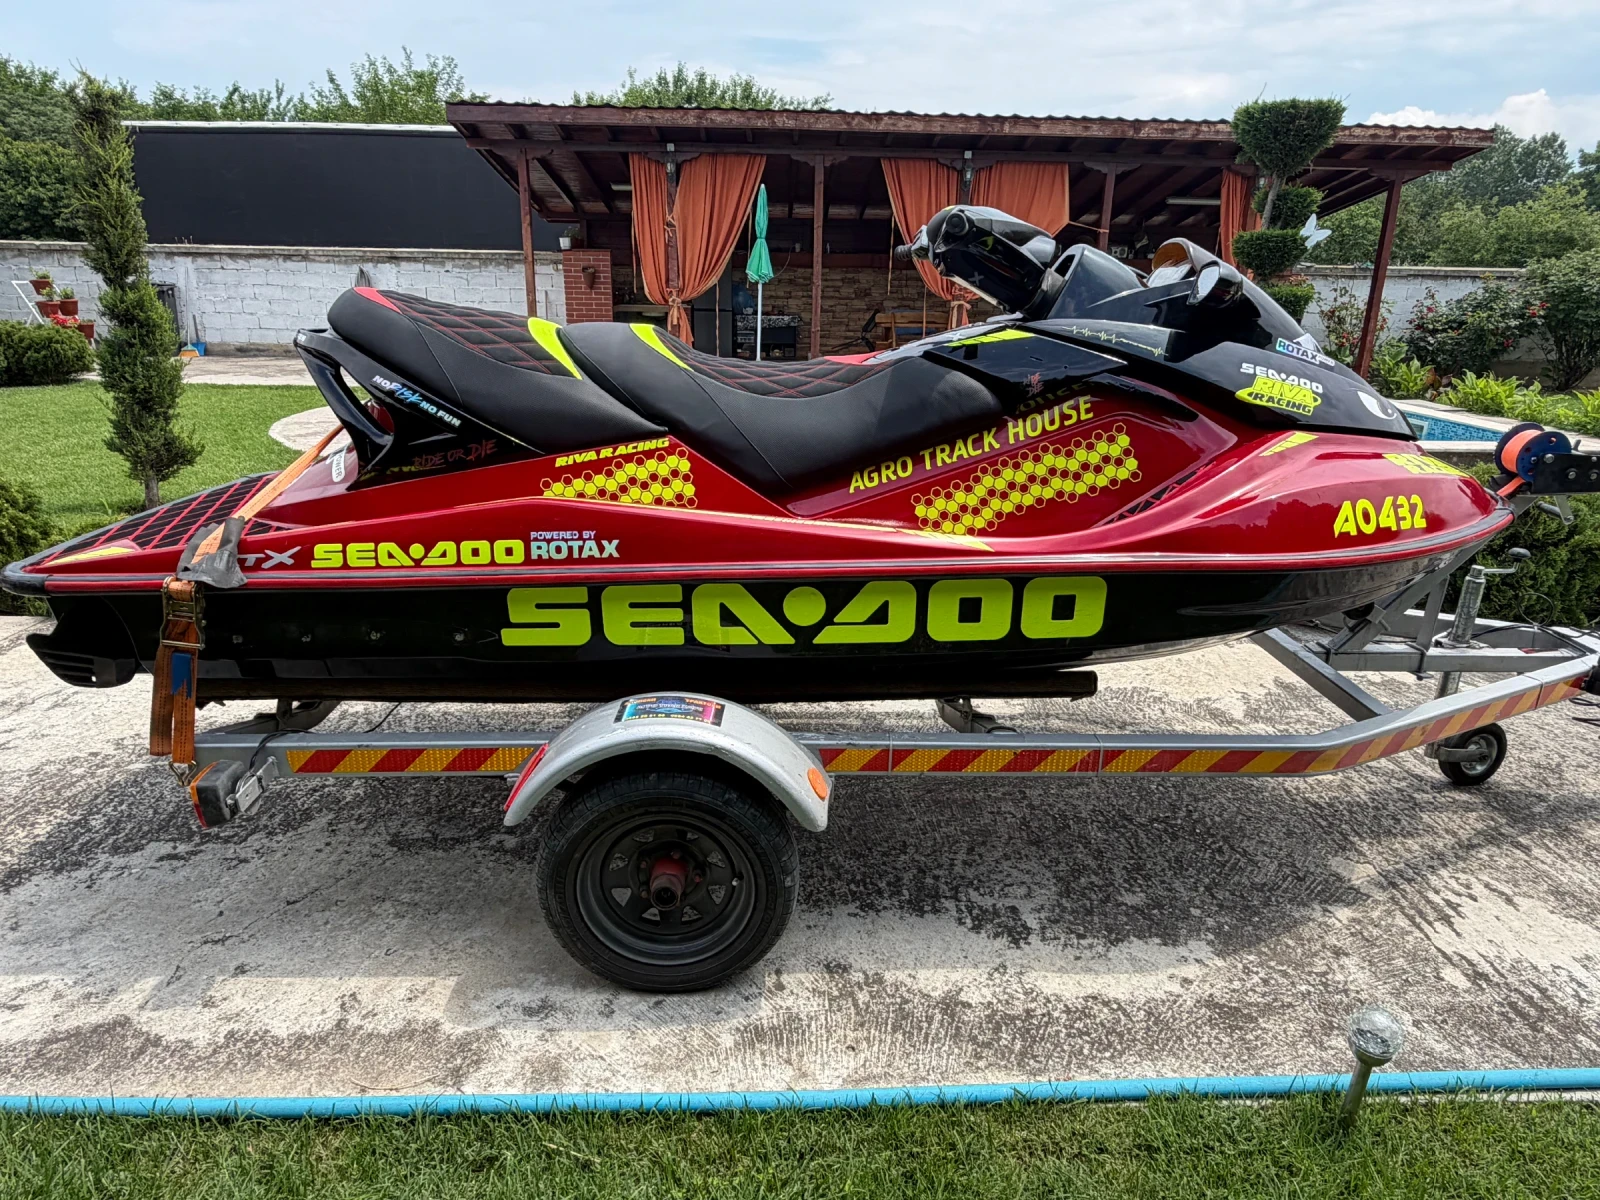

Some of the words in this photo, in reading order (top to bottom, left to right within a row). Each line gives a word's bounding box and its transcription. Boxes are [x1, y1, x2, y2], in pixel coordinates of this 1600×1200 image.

[1278, 340, 1318, 362] ROTAX
[371, 375, 391, 388] NO
[387, 383, 423, 403] RISK
[419, 401, 437, 414] NO
[437, 410, 462, 427] FUN
[1252, 392, 1312, 414] RACING
[1253, 377, 1313, 405] RIVA
[412, 452, 446, 469] RIDE
[447, 449, 467, 462] OR
[466, 439, 498, 462] DIE
[555, 451, 598, 467] RIVA
[599, 438, 670, 458] RACING
[849, 456, 913, 493] AGRO
[919, 427, 1000, 471] TRACK
[1007, 395, 1094, 444] HOUSE
[530, 531, 580, 540] POWERED
[582, 530, 597, 540] BY
[530, 540, 620, 560] ROTAX
